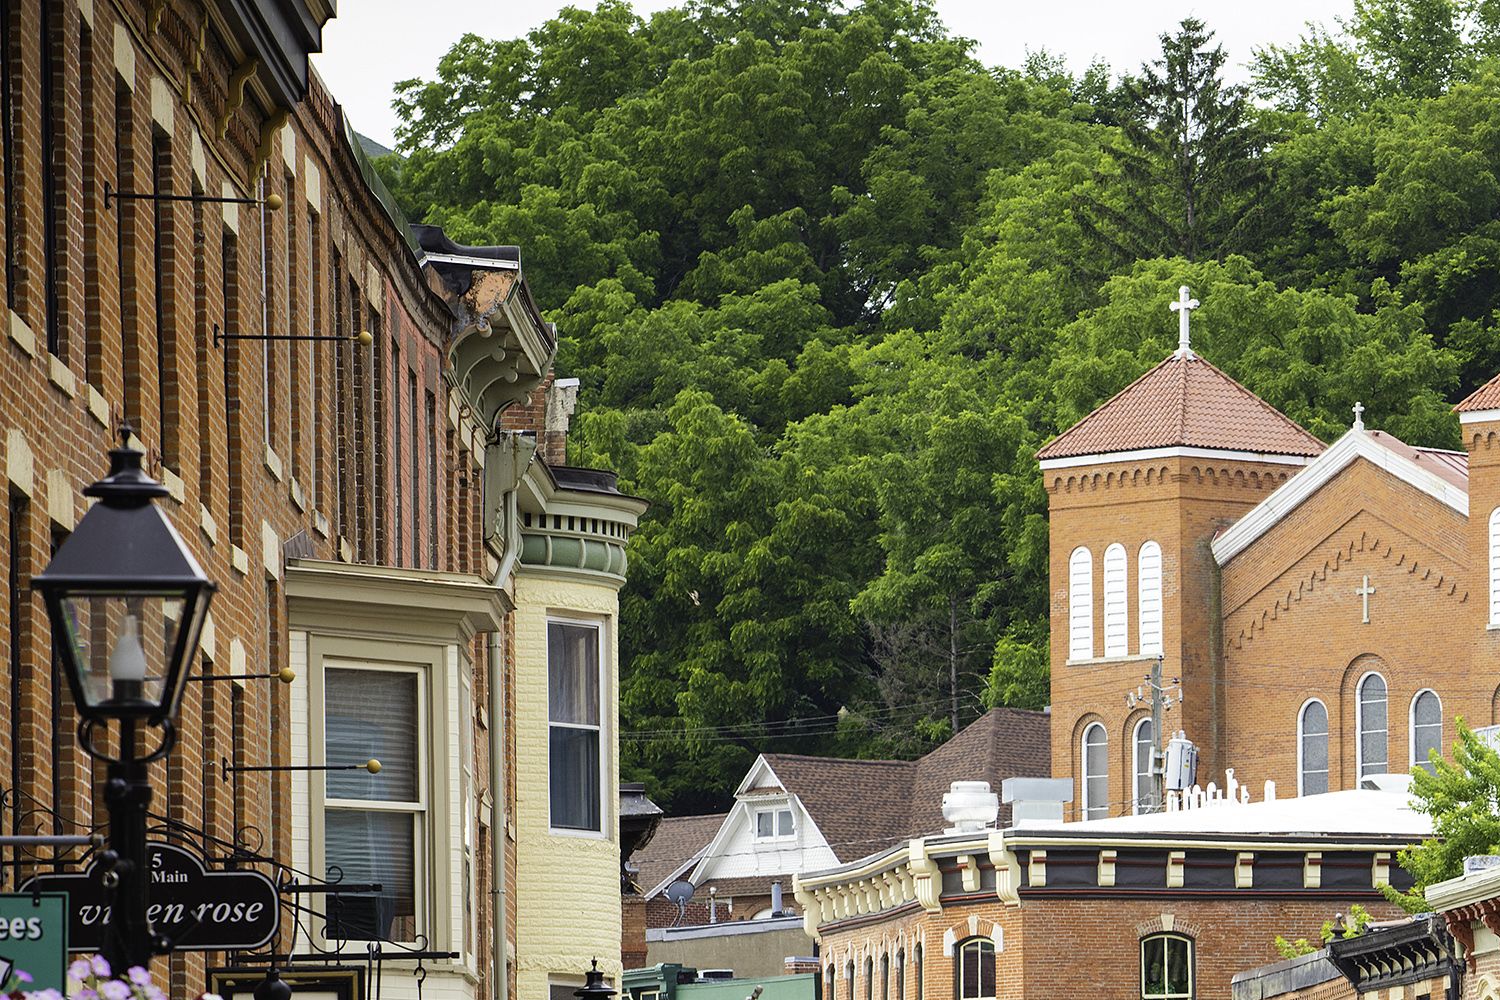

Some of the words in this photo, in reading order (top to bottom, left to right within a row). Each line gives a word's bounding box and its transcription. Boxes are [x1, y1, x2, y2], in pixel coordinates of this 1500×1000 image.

[150, 870, 188, 883] Main
[79, 903, 184, 926] vien
[197, 900, 264, 924] rose
